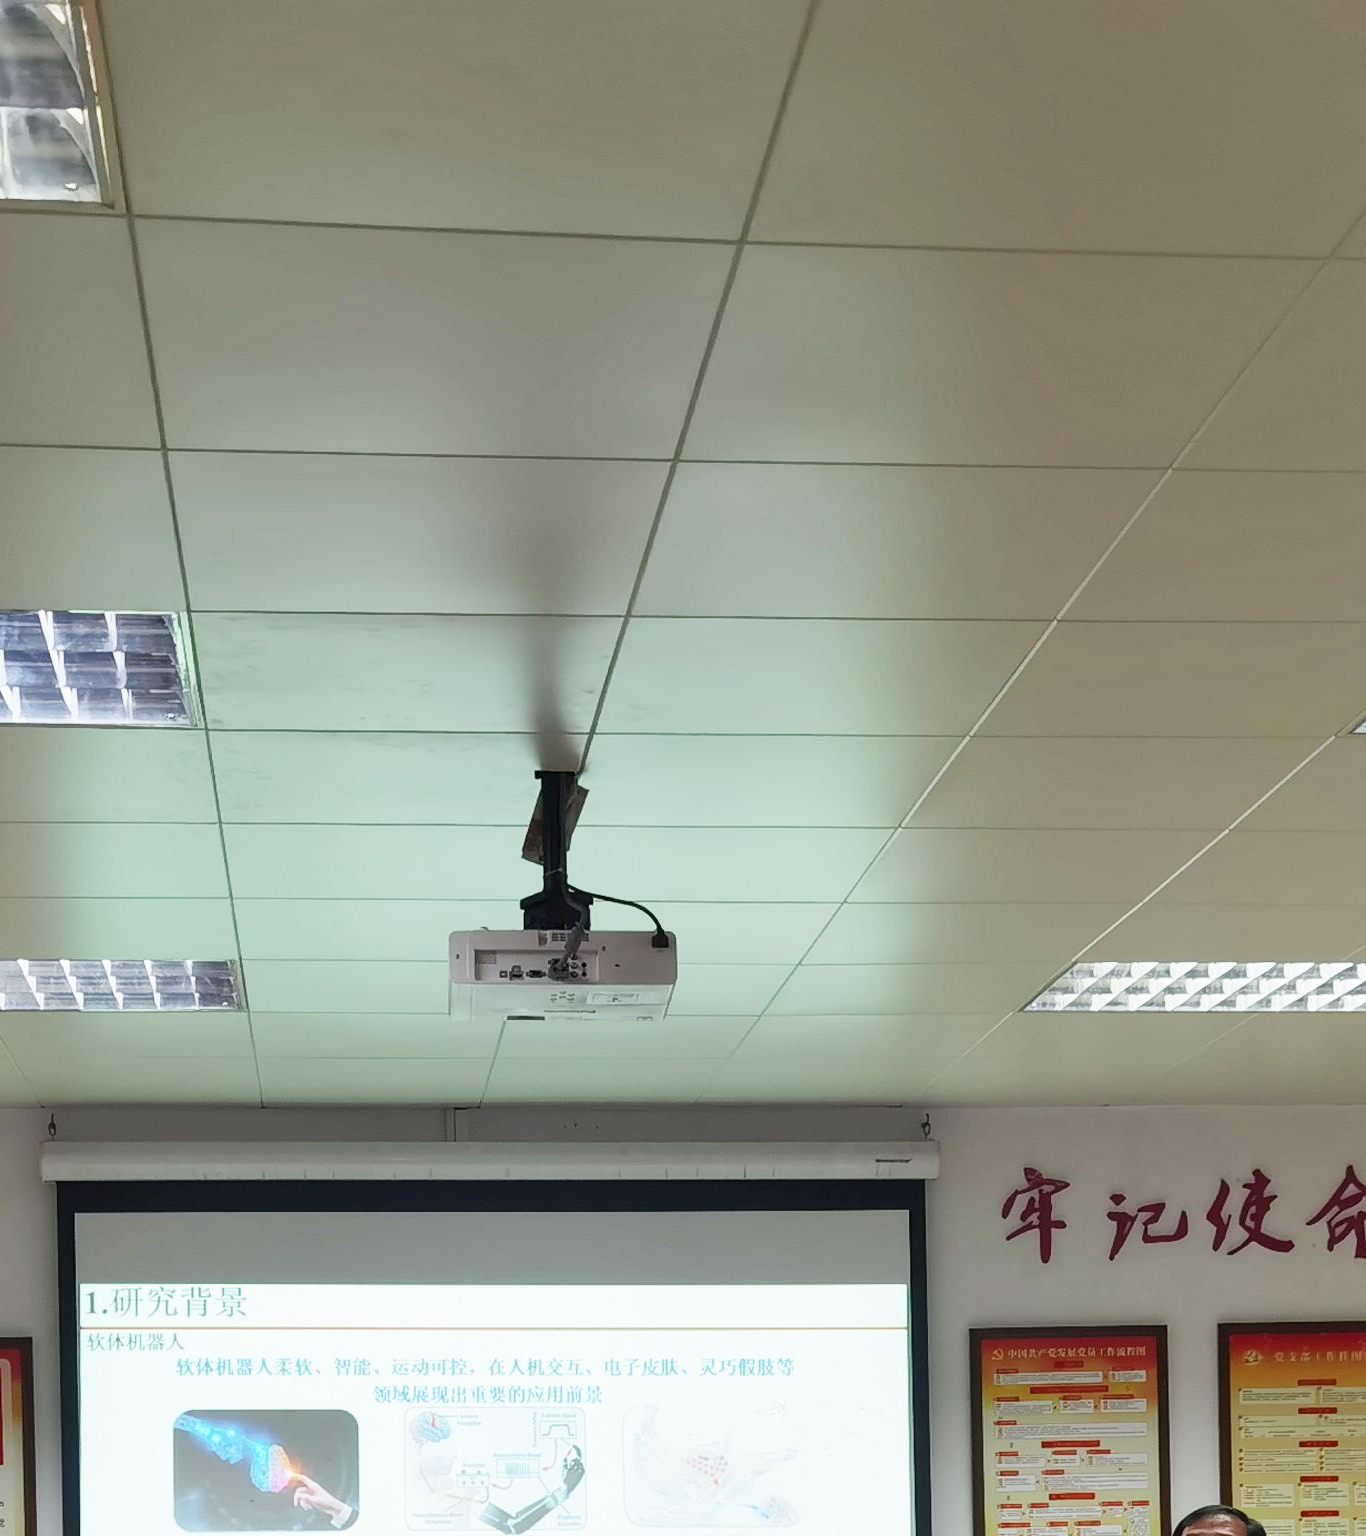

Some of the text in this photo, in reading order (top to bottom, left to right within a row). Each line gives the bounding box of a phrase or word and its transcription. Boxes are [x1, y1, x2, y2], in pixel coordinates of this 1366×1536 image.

[85, 1286, 247, 1318] 1.研究背景
[87, 1332, 184, 1351] 软体机器人
[373, 1385, 602, 1403] 领域展现出重要的应用前景
